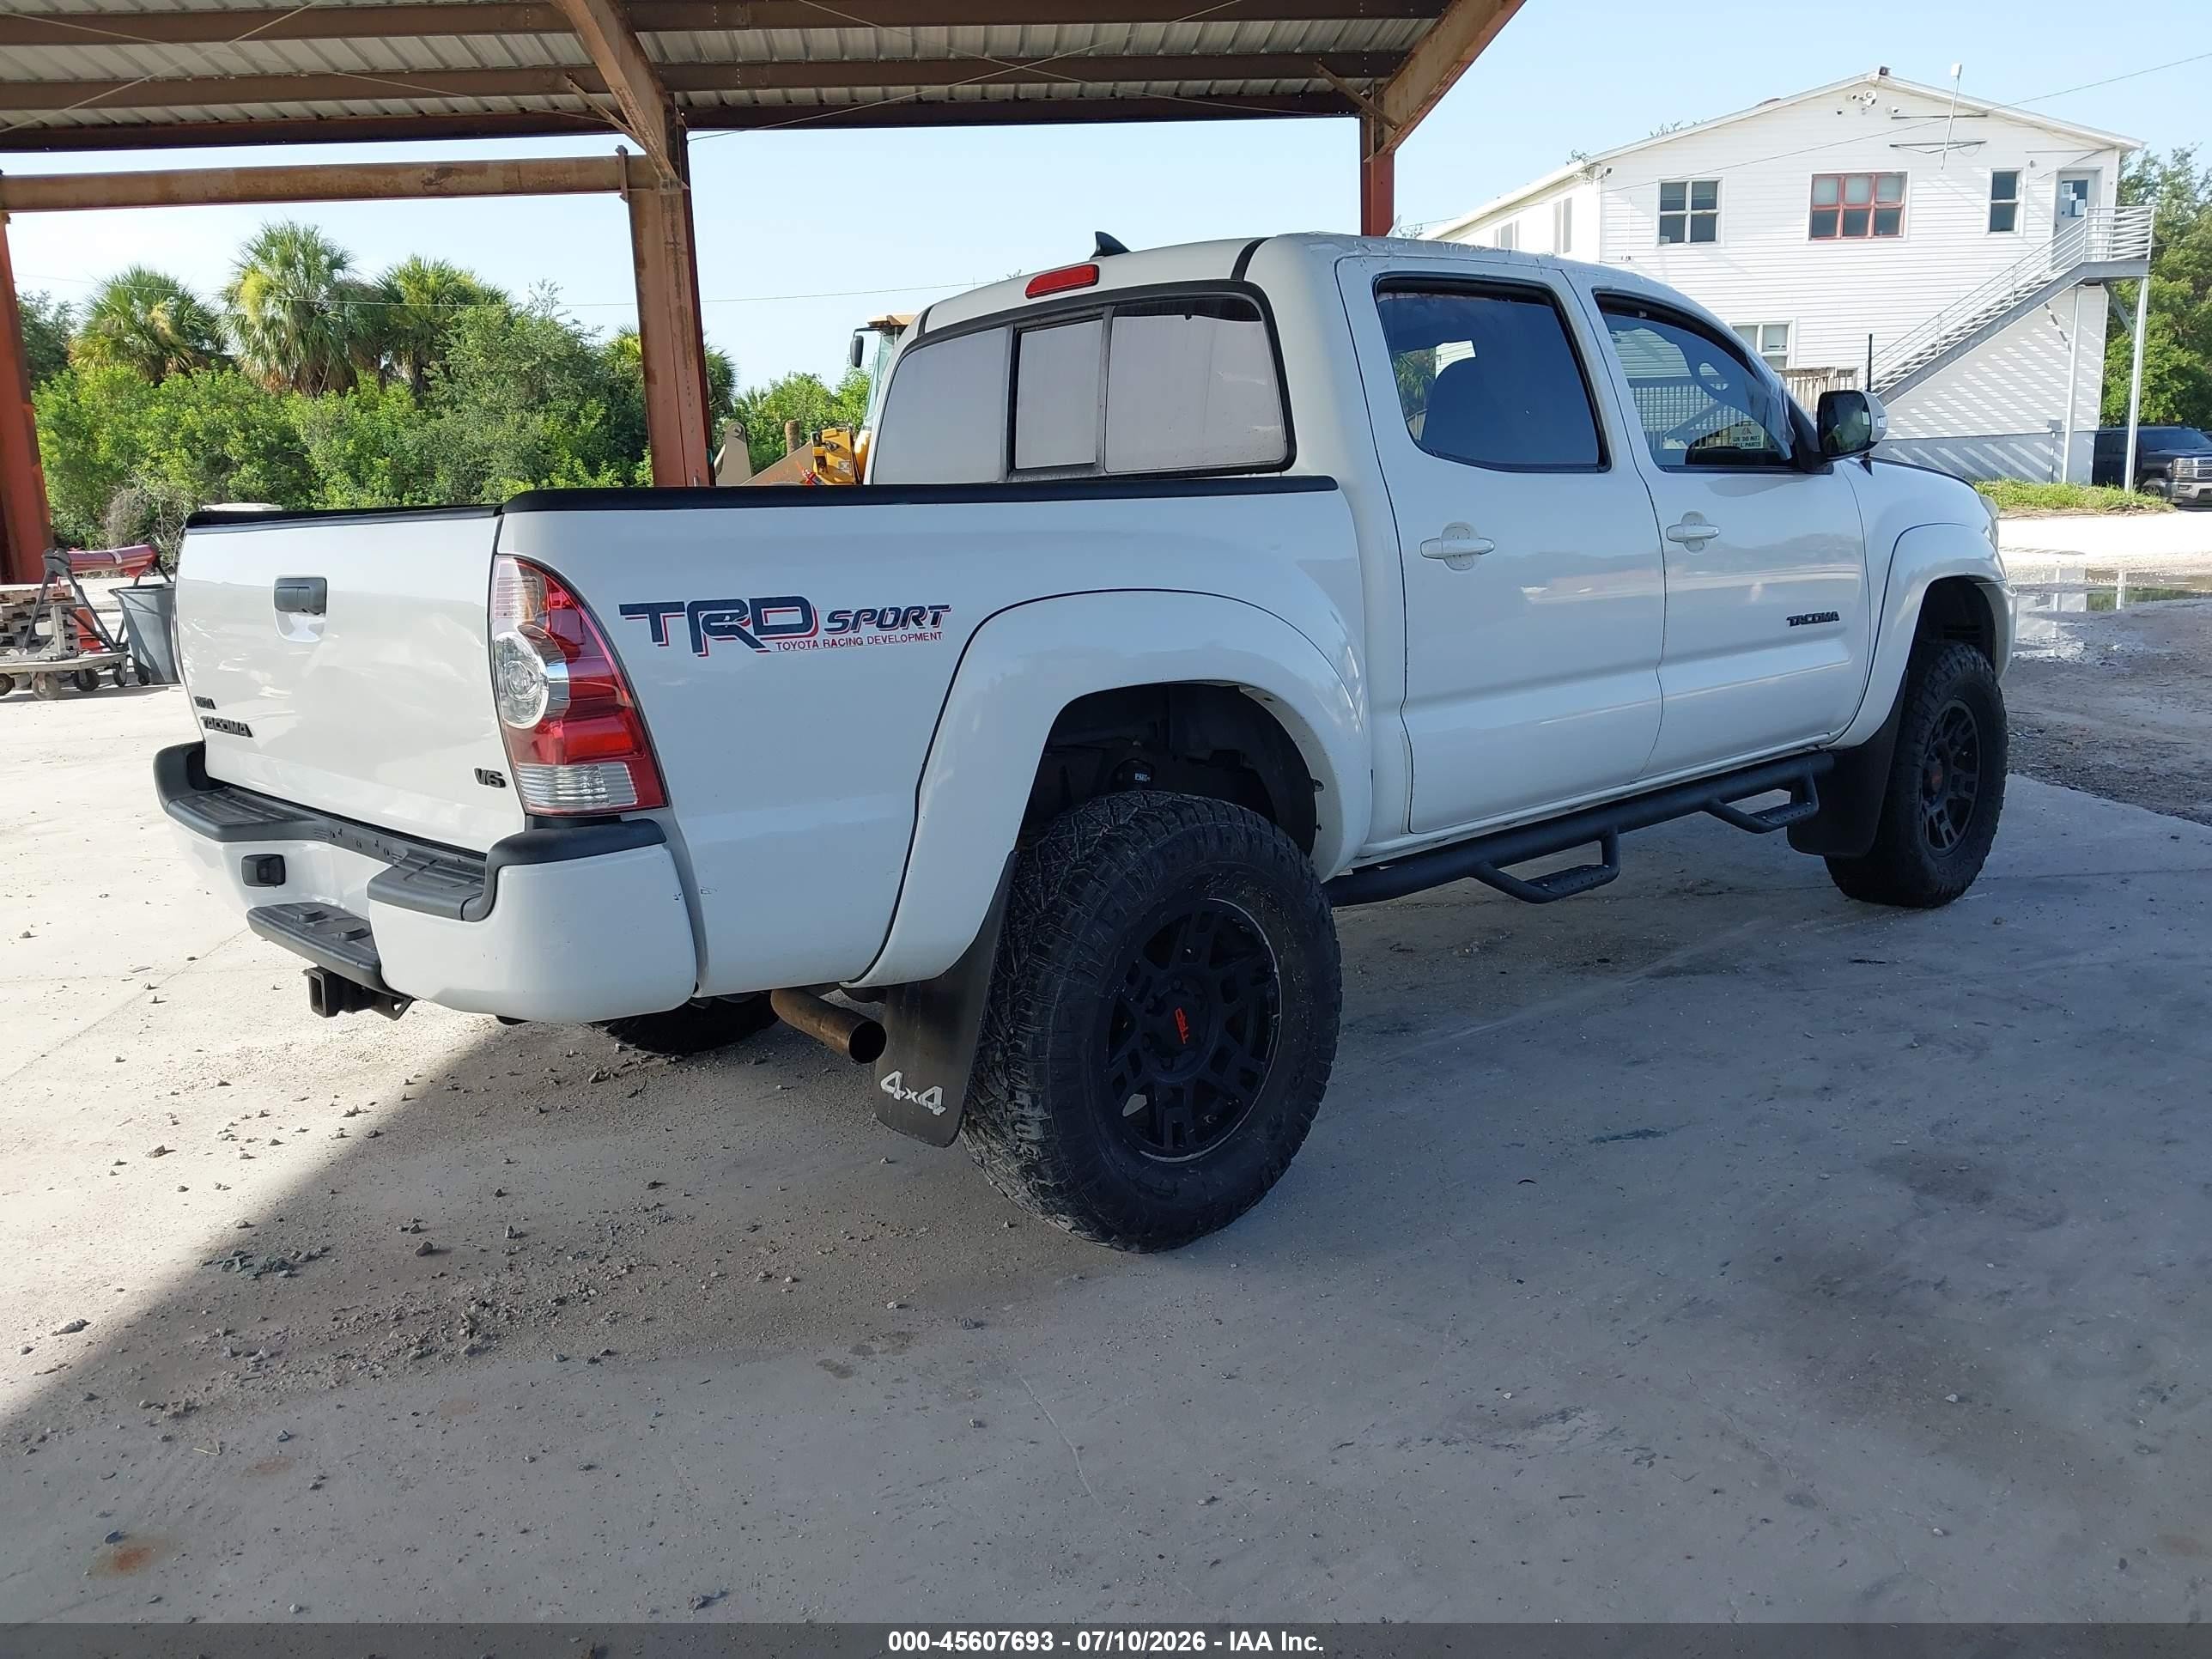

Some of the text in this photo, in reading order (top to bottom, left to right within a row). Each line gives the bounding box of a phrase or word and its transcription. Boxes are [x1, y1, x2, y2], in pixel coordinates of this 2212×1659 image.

[618, 596, 951, 657] TRD SPORT
[1787, 611, 1840, 627] TACOMA
[775, 631, 944, 652] TOYOTA RACING DEVELOPMENT
[199, 715, 253, 738] TACOMA
[474, 768, 506, 788] V6
[880, 1070, 946, 1115] 4x4
